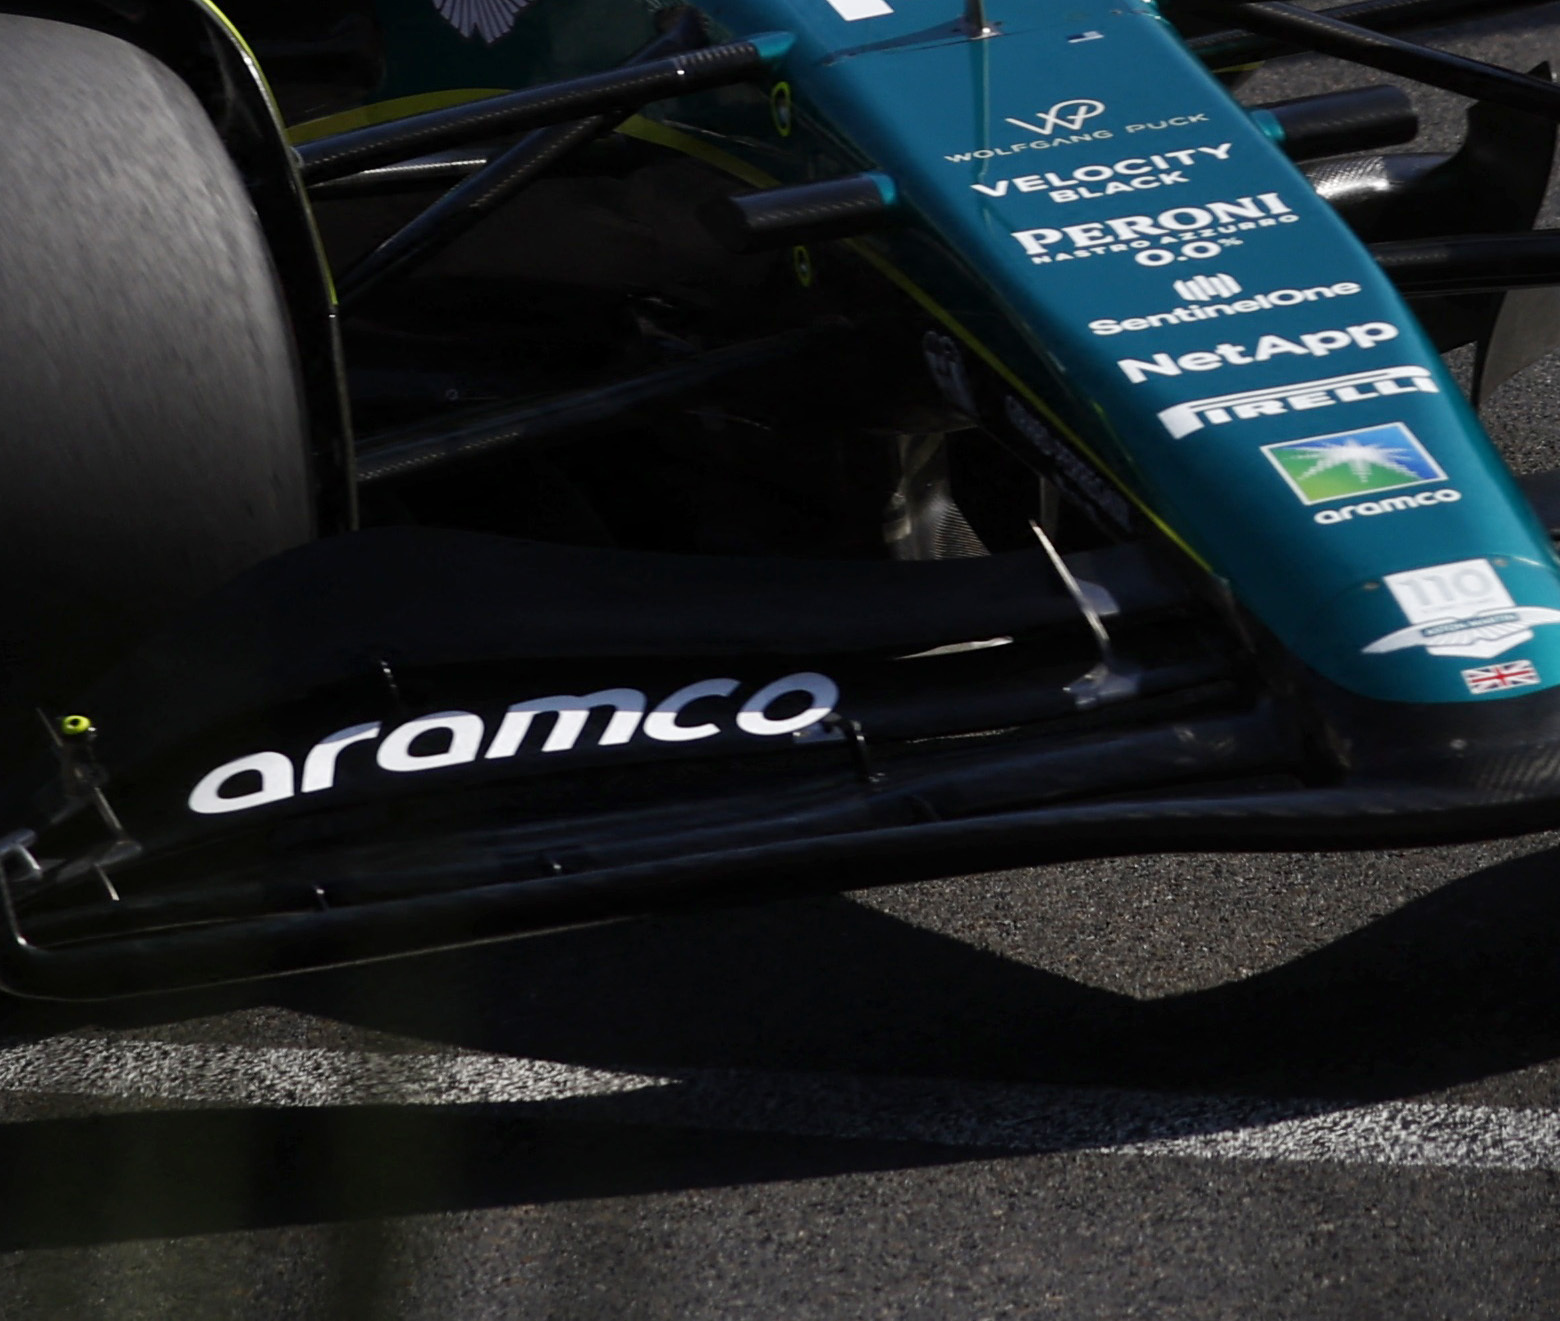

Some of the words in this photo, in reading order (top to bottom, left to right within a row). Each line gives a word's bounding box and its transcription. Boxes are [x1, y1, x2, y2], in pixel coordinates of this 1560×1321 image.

[943, 130, 1114, 164] WOLFGANG
[1124, 112, 1211, 134] PUCK
[970, 142, 1233, 198] VELOCITY
[1047, 170, 1191, 204] BLACK
[1010, 191, 1294, 256] PERONI
[1030, 238, 1152, 265] NASTRO
[1159, 213, 1300, 245] AZZURRO
[1134, 236, 1244, 268] 0.0%
[1088, 281, 1362, 336] SentinelOne
[1116, 320, 1400, 384] NetApp
[1157, 365, 1439, 440] PIRELLI
[1314, 487, 1463, 525] aramco
[188, 672, 839, 815] aramco
